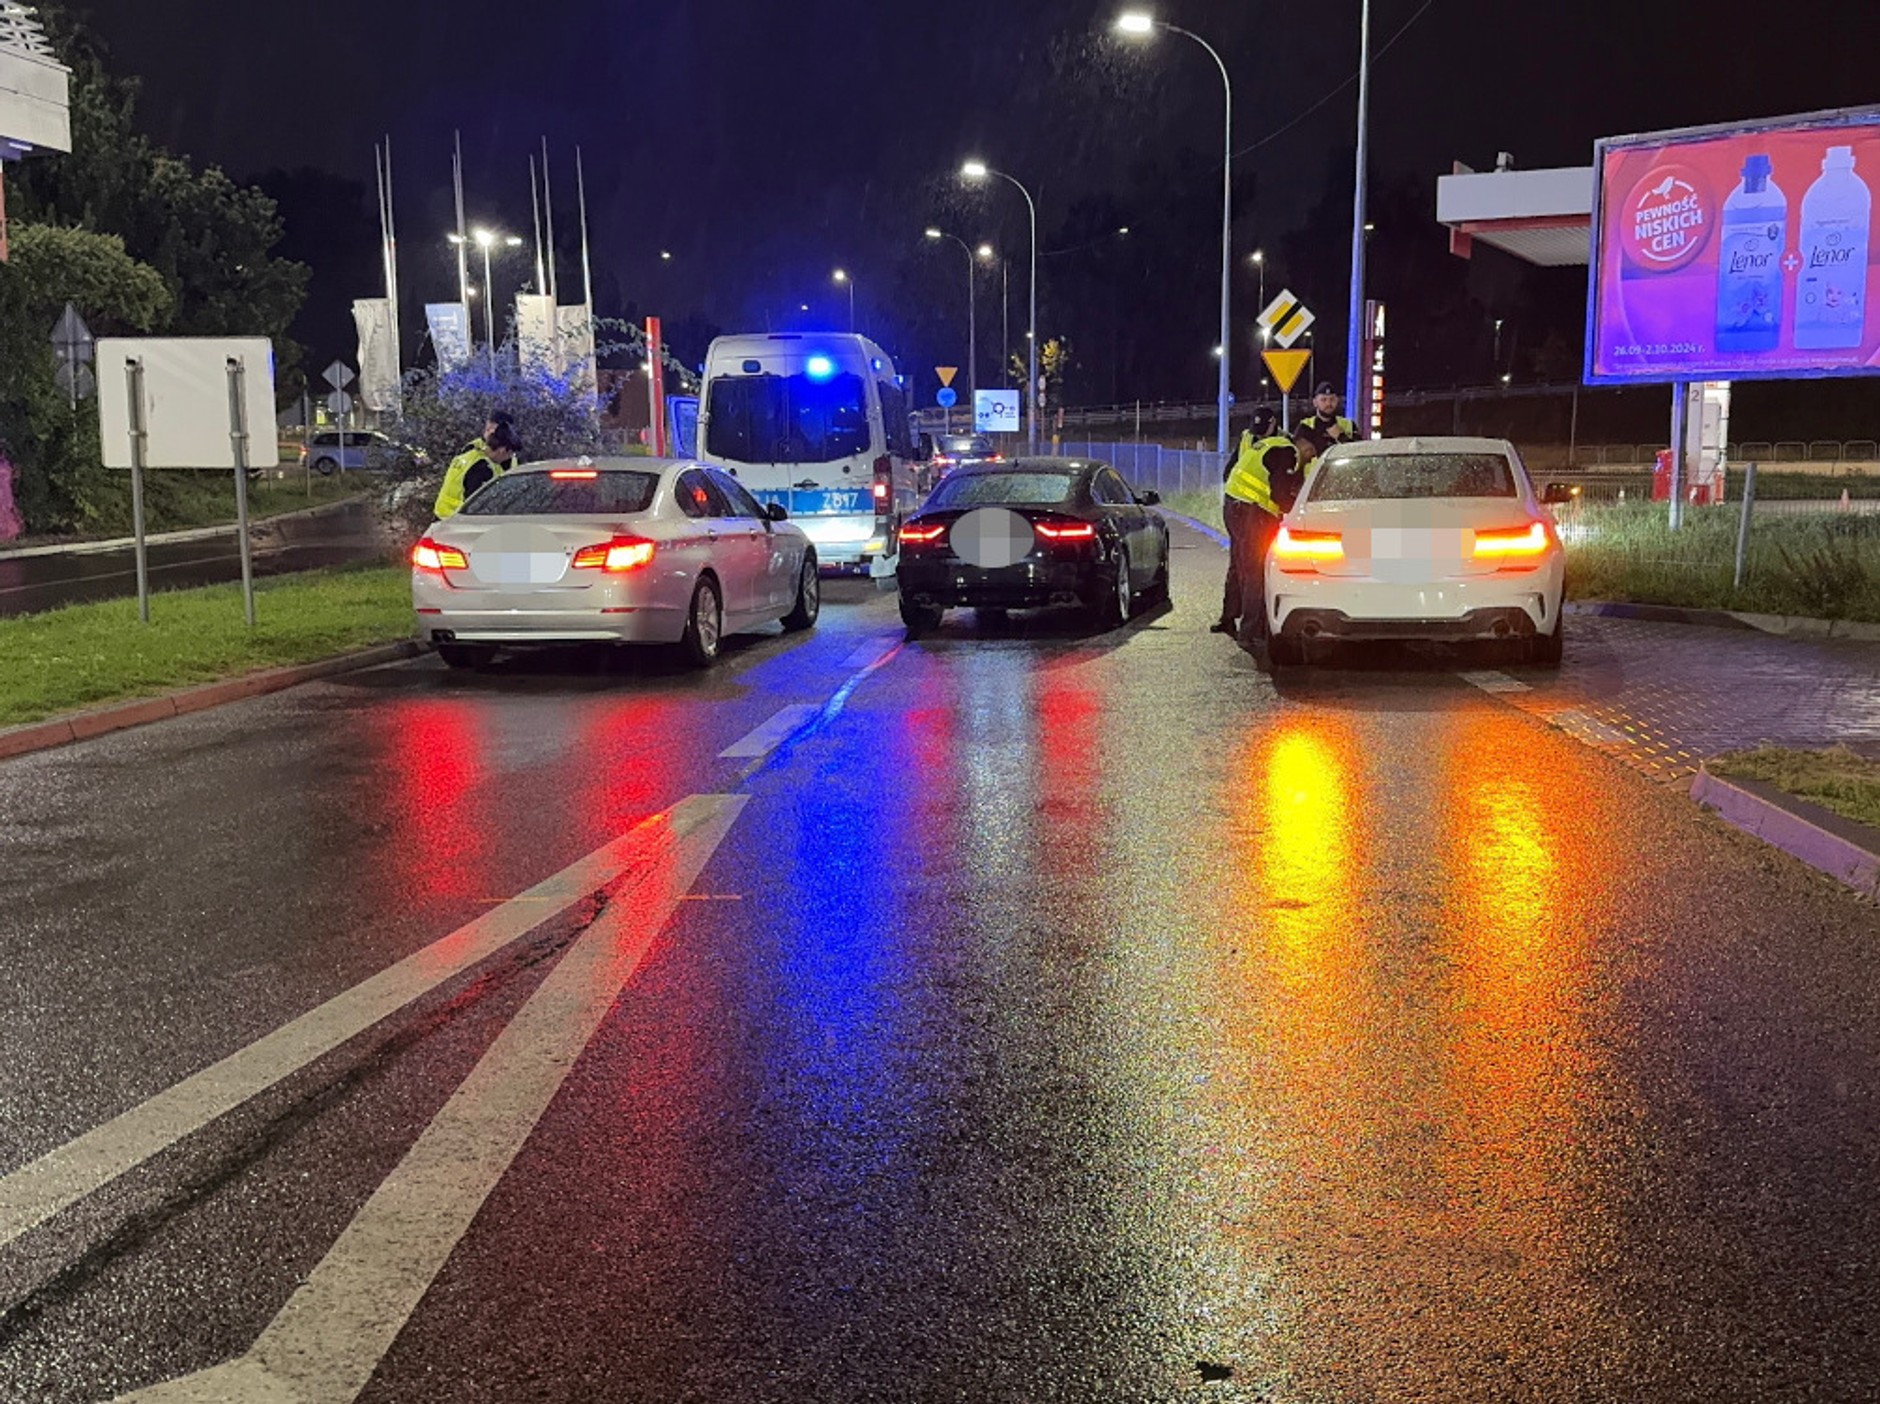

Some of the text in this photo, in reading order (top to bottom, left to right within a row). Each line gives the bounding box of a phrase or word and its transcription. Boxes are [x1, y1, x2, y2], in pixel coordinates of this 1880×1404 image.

[1636, 193, 1698, 224] PEWNOŚĆ
[1635, 209, 1703, 241] NISKICH
[1652, 230, 1685, 252] CEN
[1728, 250, 1773, 274] Lenor
[1809, 245, 1855, 269] Lenor
